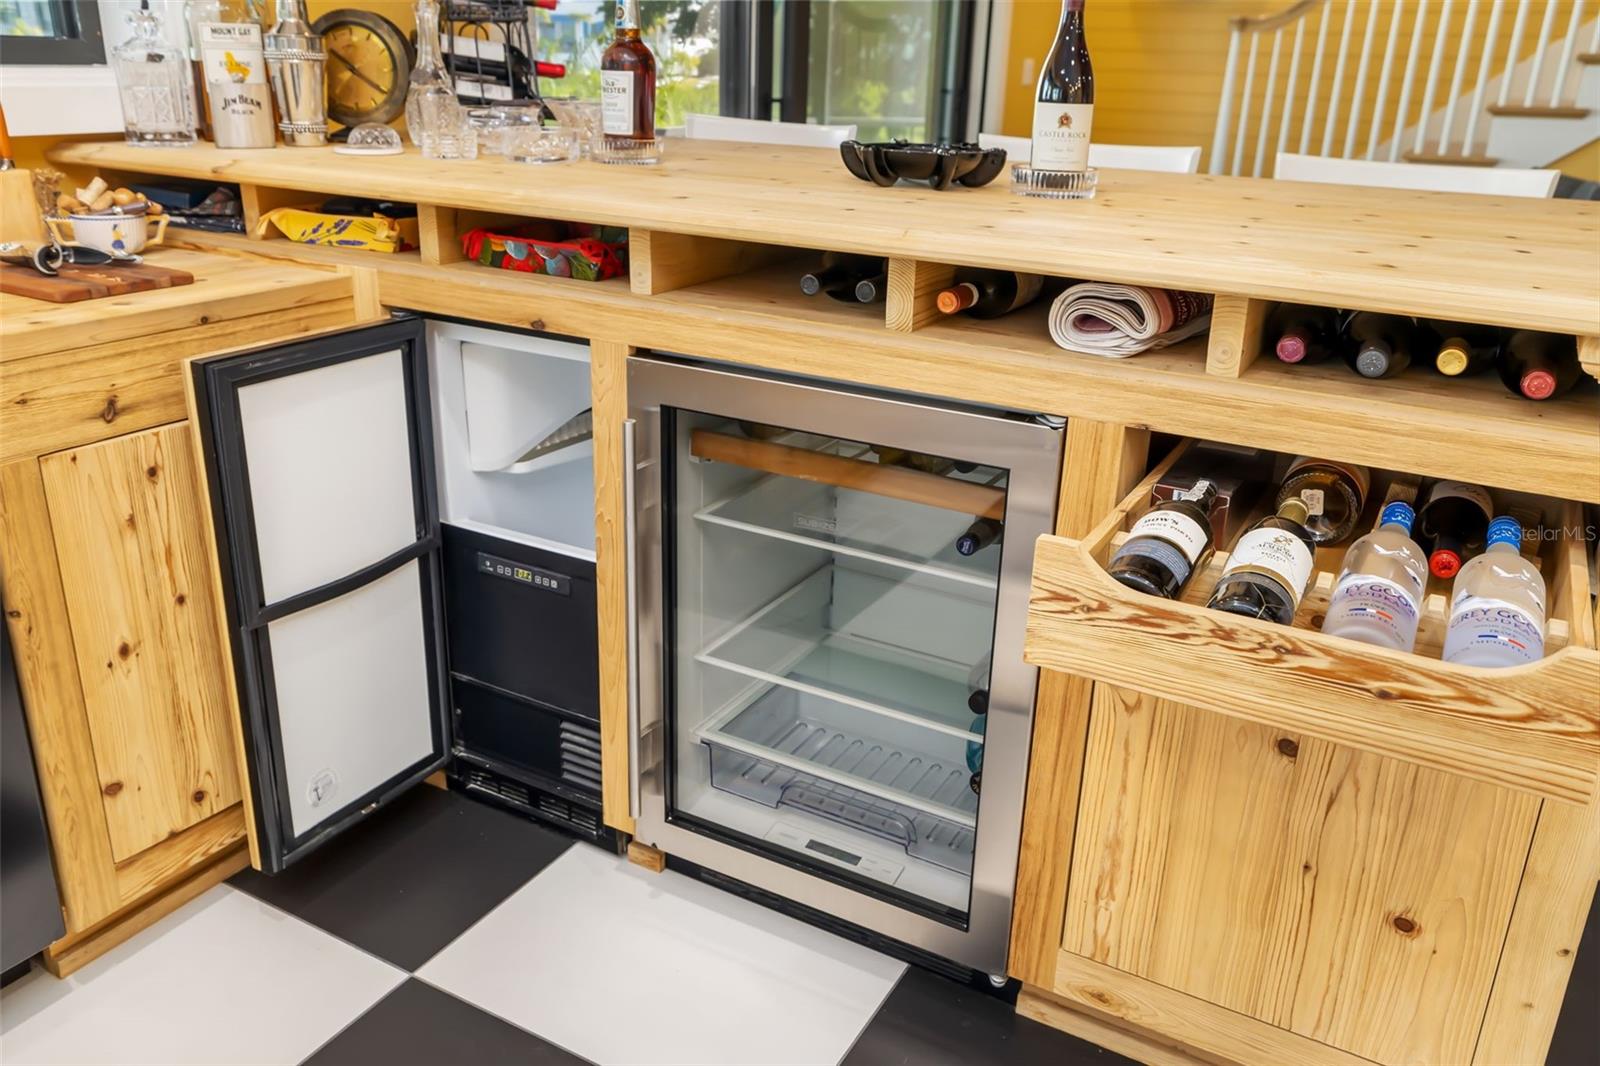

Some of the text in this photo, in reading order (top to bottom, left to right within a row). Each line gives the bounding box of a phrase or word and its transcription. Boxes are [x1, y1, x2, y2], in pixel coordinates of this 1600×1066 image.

[210, 27, 236, 35] MOUNT
[221, 95, 263, 111] JIM BEAM
[1450, 608, 1491, 629] GREY
[1475, 616, 1531, 636] VODKA
